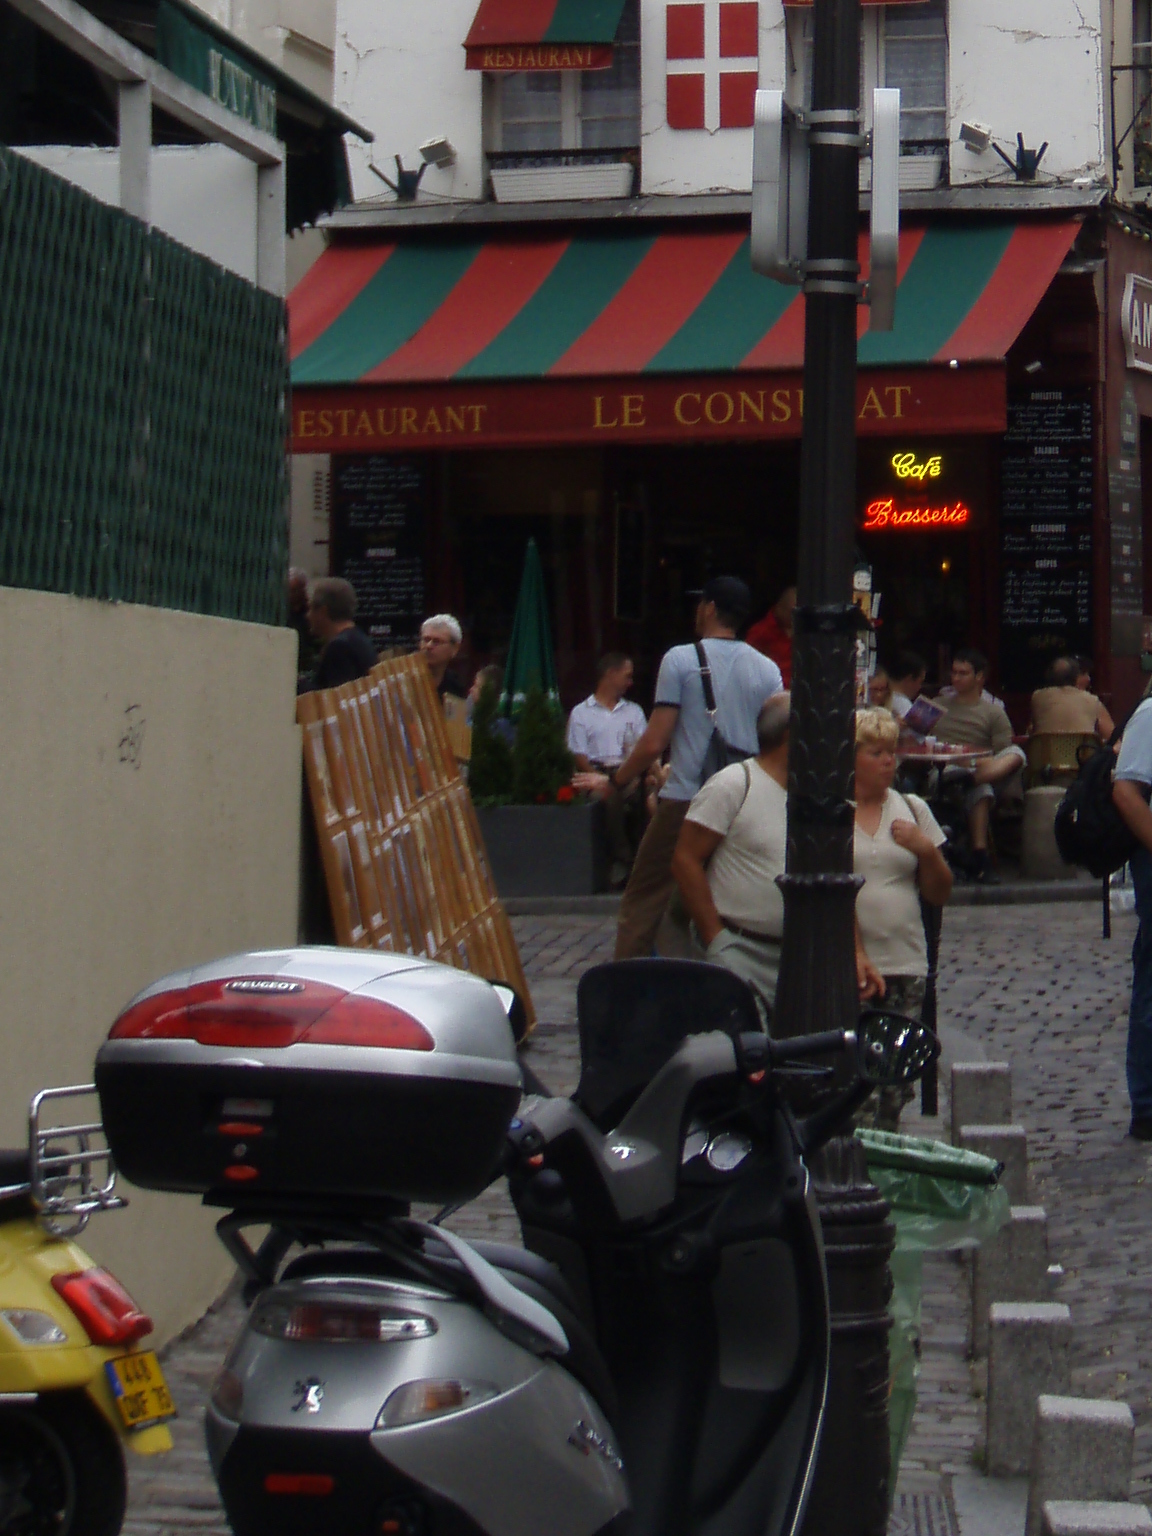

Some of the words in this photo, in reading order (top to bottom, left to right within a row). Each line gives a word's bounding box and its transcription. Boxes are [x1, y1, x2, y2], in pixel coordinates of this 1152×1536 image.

[483, 44, 595, 69] RESTAURANT
[290, 405, 488, 438] ESTAURANT
[592, 394, 648, 429] LE
[673, 385, 913, 427] CONSAT
[891, 452, 942, 481] Café
[864, 498, 969, 527] Brasserie
[231, 980, 299, 991] PEUGEOT
